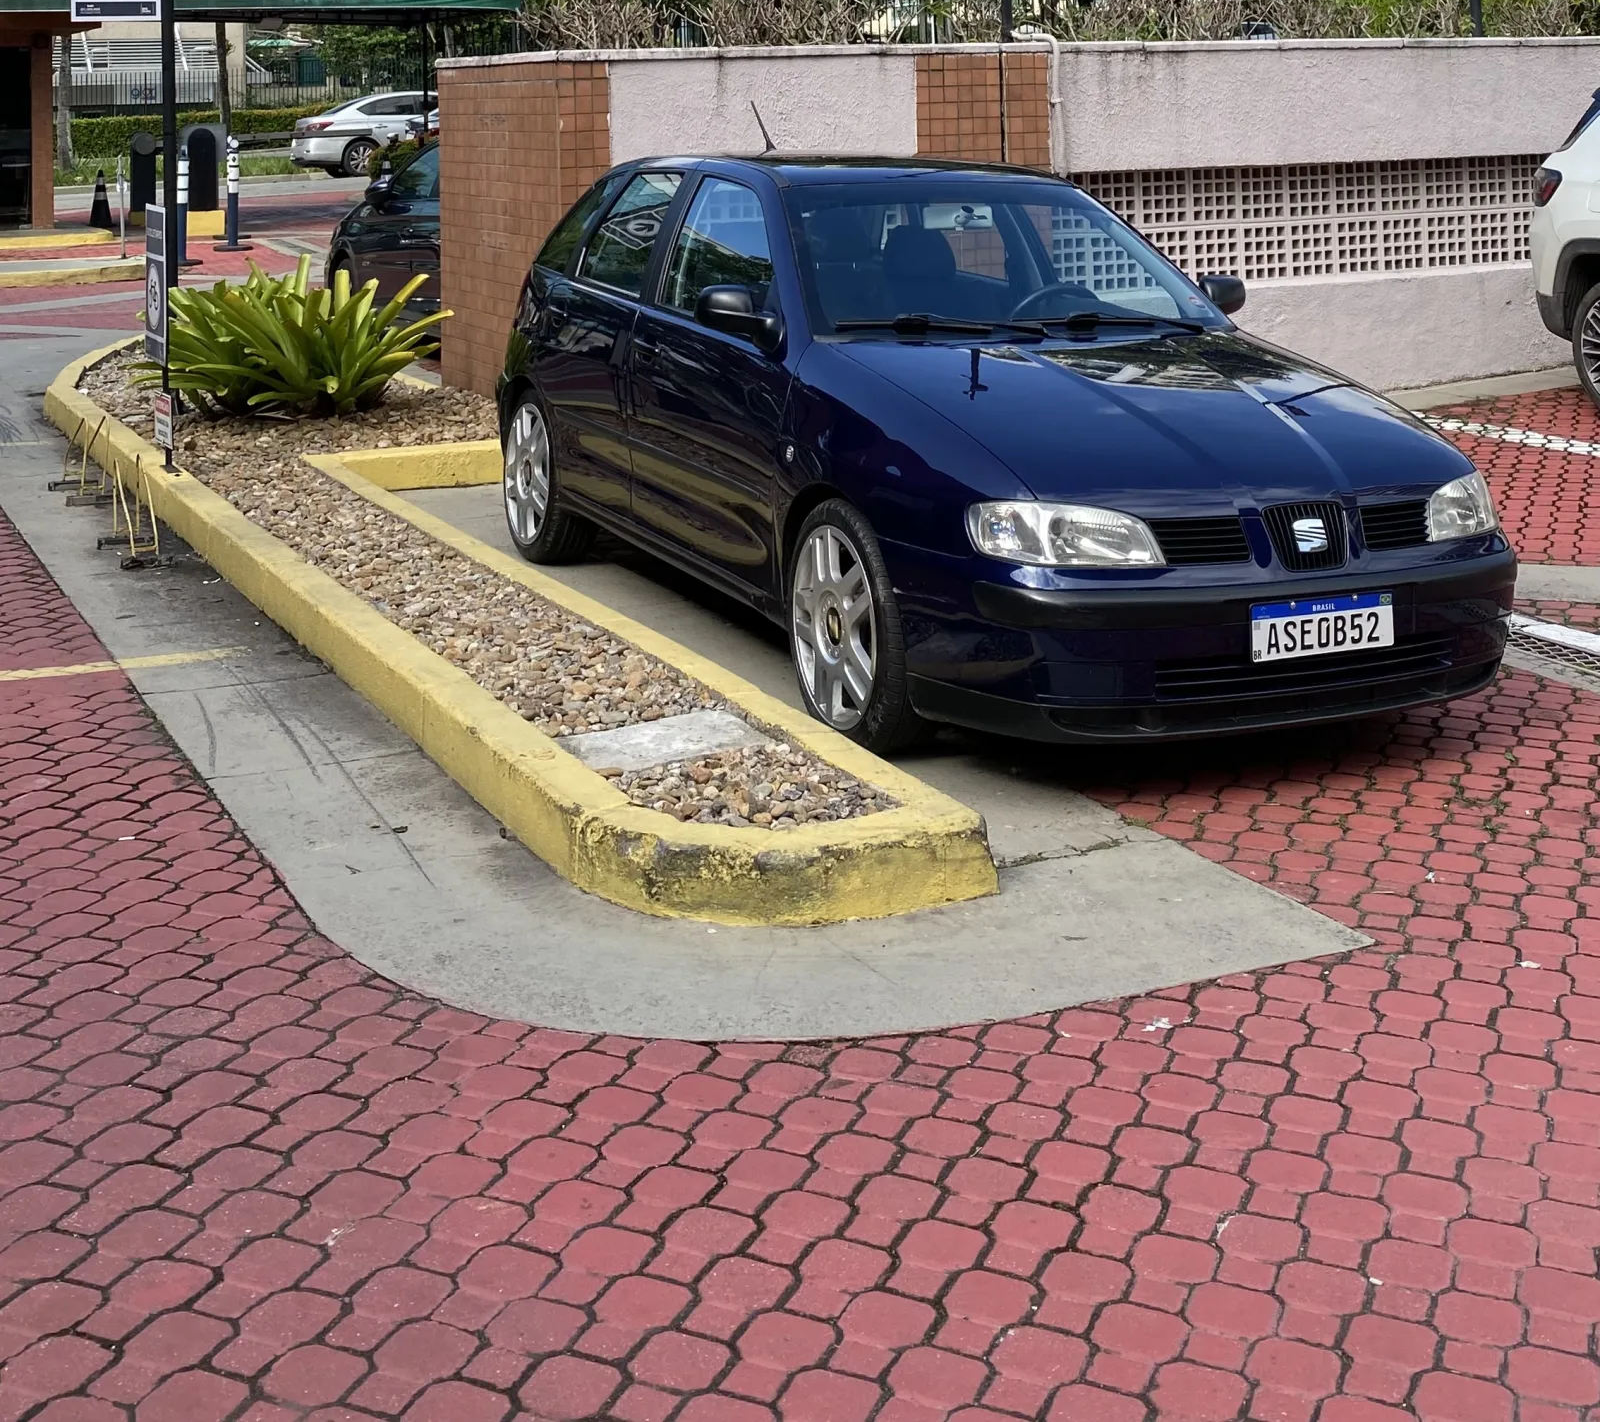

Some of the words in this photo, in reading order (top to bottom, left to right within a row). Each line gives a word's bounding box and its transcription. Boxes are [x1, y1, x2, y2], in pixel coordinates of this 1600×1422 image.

[1312, 603, 1336, 612] BRASIL
[1266, 611, 1380, 656] ASE0B52
[1253, 649, 1262, 660] BR
